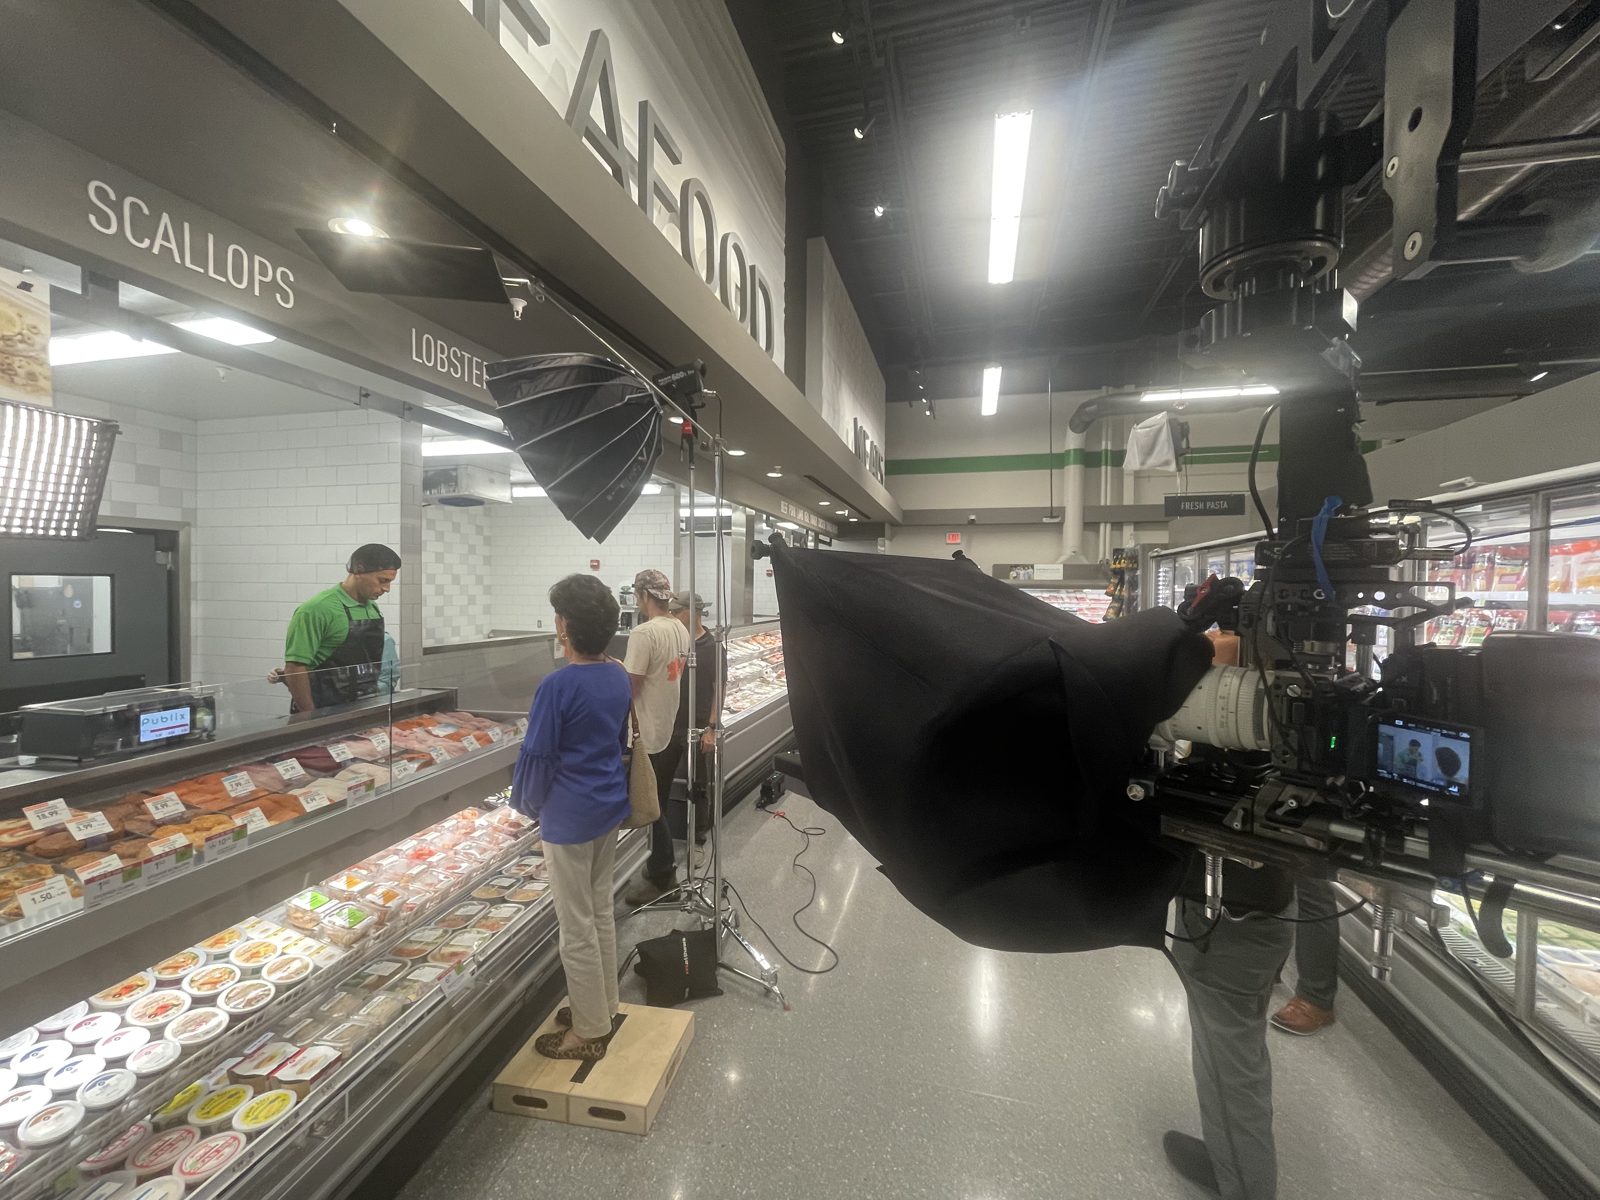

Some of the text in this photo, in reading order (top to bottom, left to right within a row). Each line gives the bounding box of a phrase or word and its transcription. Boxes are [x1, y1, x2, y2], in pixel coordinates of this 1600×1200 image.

[472, 0, 775, 359] AFOOD
[87, 180, 295, 309] SCALLOPS
[1181, 500, 1228, 511] FRESH PASTA
[30, 892, 53, 905] 1.50
